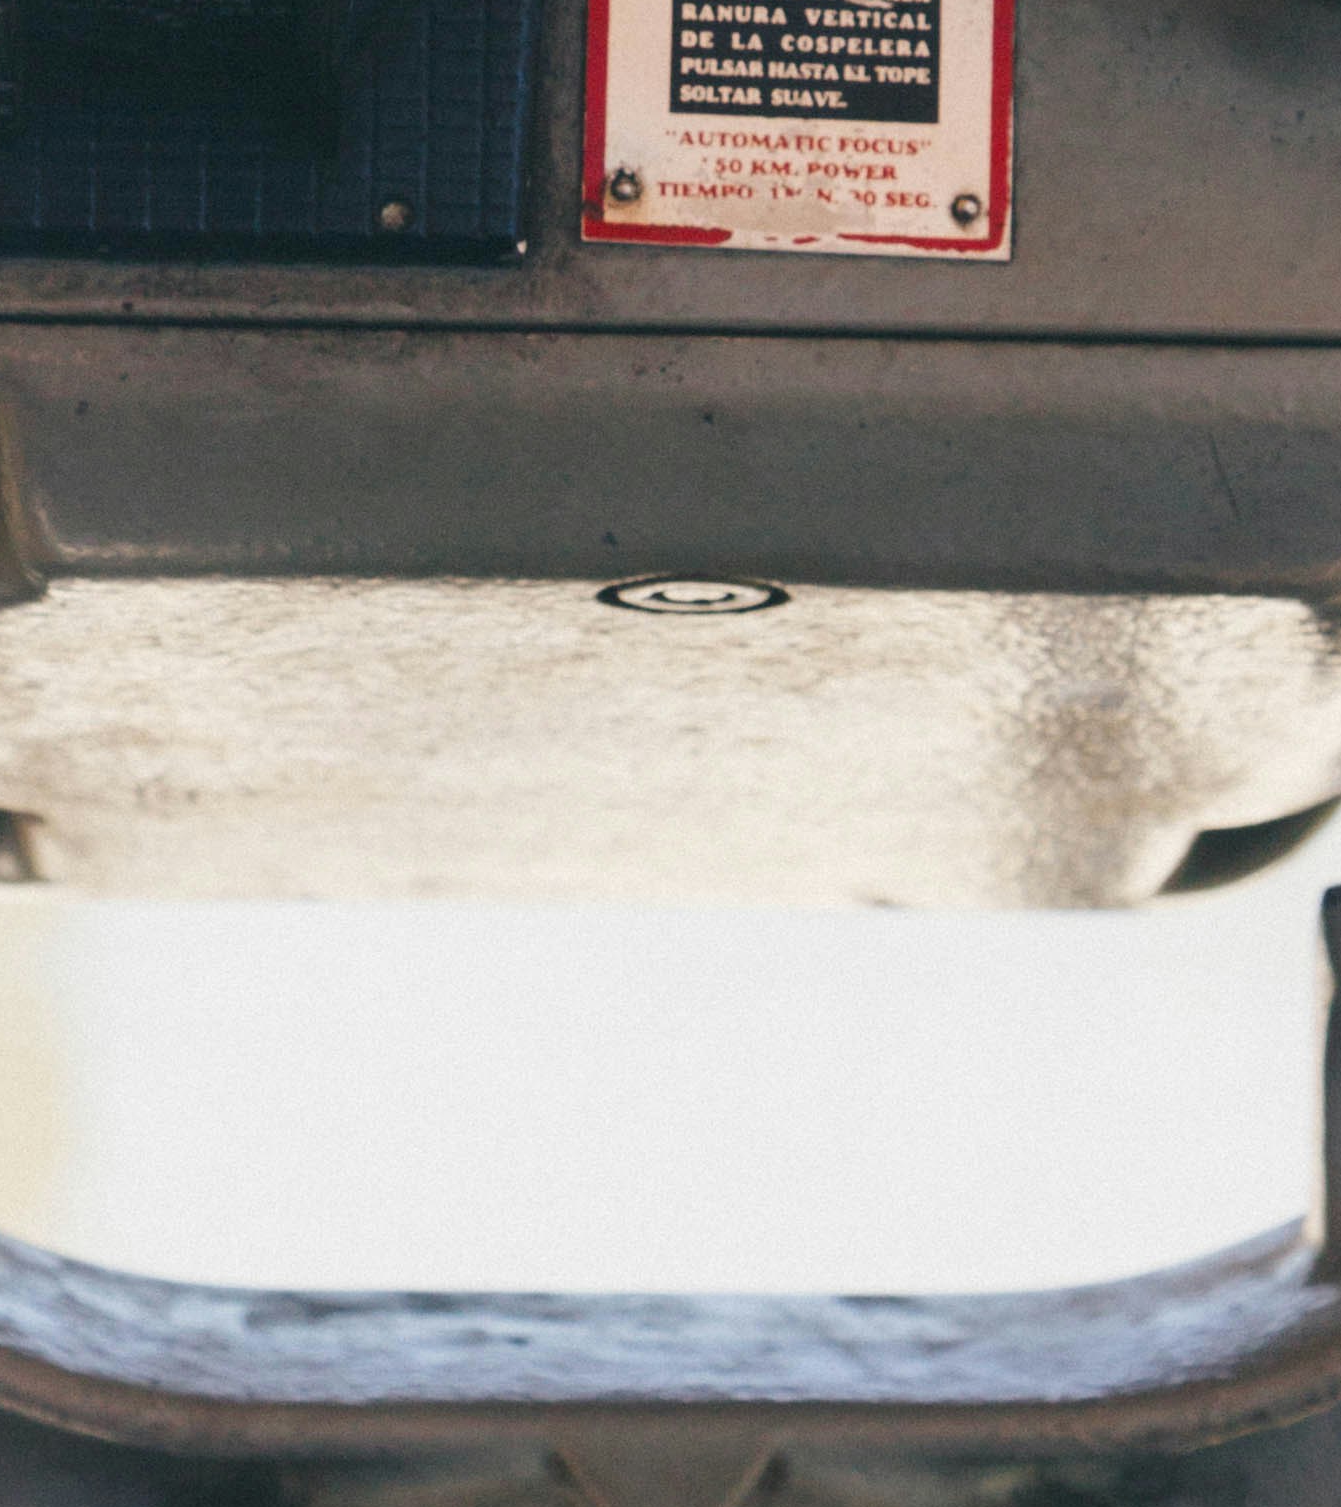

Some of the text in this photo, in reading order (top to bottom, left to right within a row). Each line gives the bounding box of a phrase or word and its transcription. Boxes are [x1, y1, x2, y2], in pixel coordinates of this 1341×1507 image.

[681, 2, 932, 30] RANURA VERTICAL
[681, 30, 931, 58] DE LA COSPELERA
[680, 57, 931, 85] PULSAR HASTA EL TOPE
[679, 84, 848, 109] SOLTAR SUAVE.
[808, 162, 899, 181] POWER
[656, 181, 754, 200] TIEMPO
[884, 191, 938, 209] SEG.
